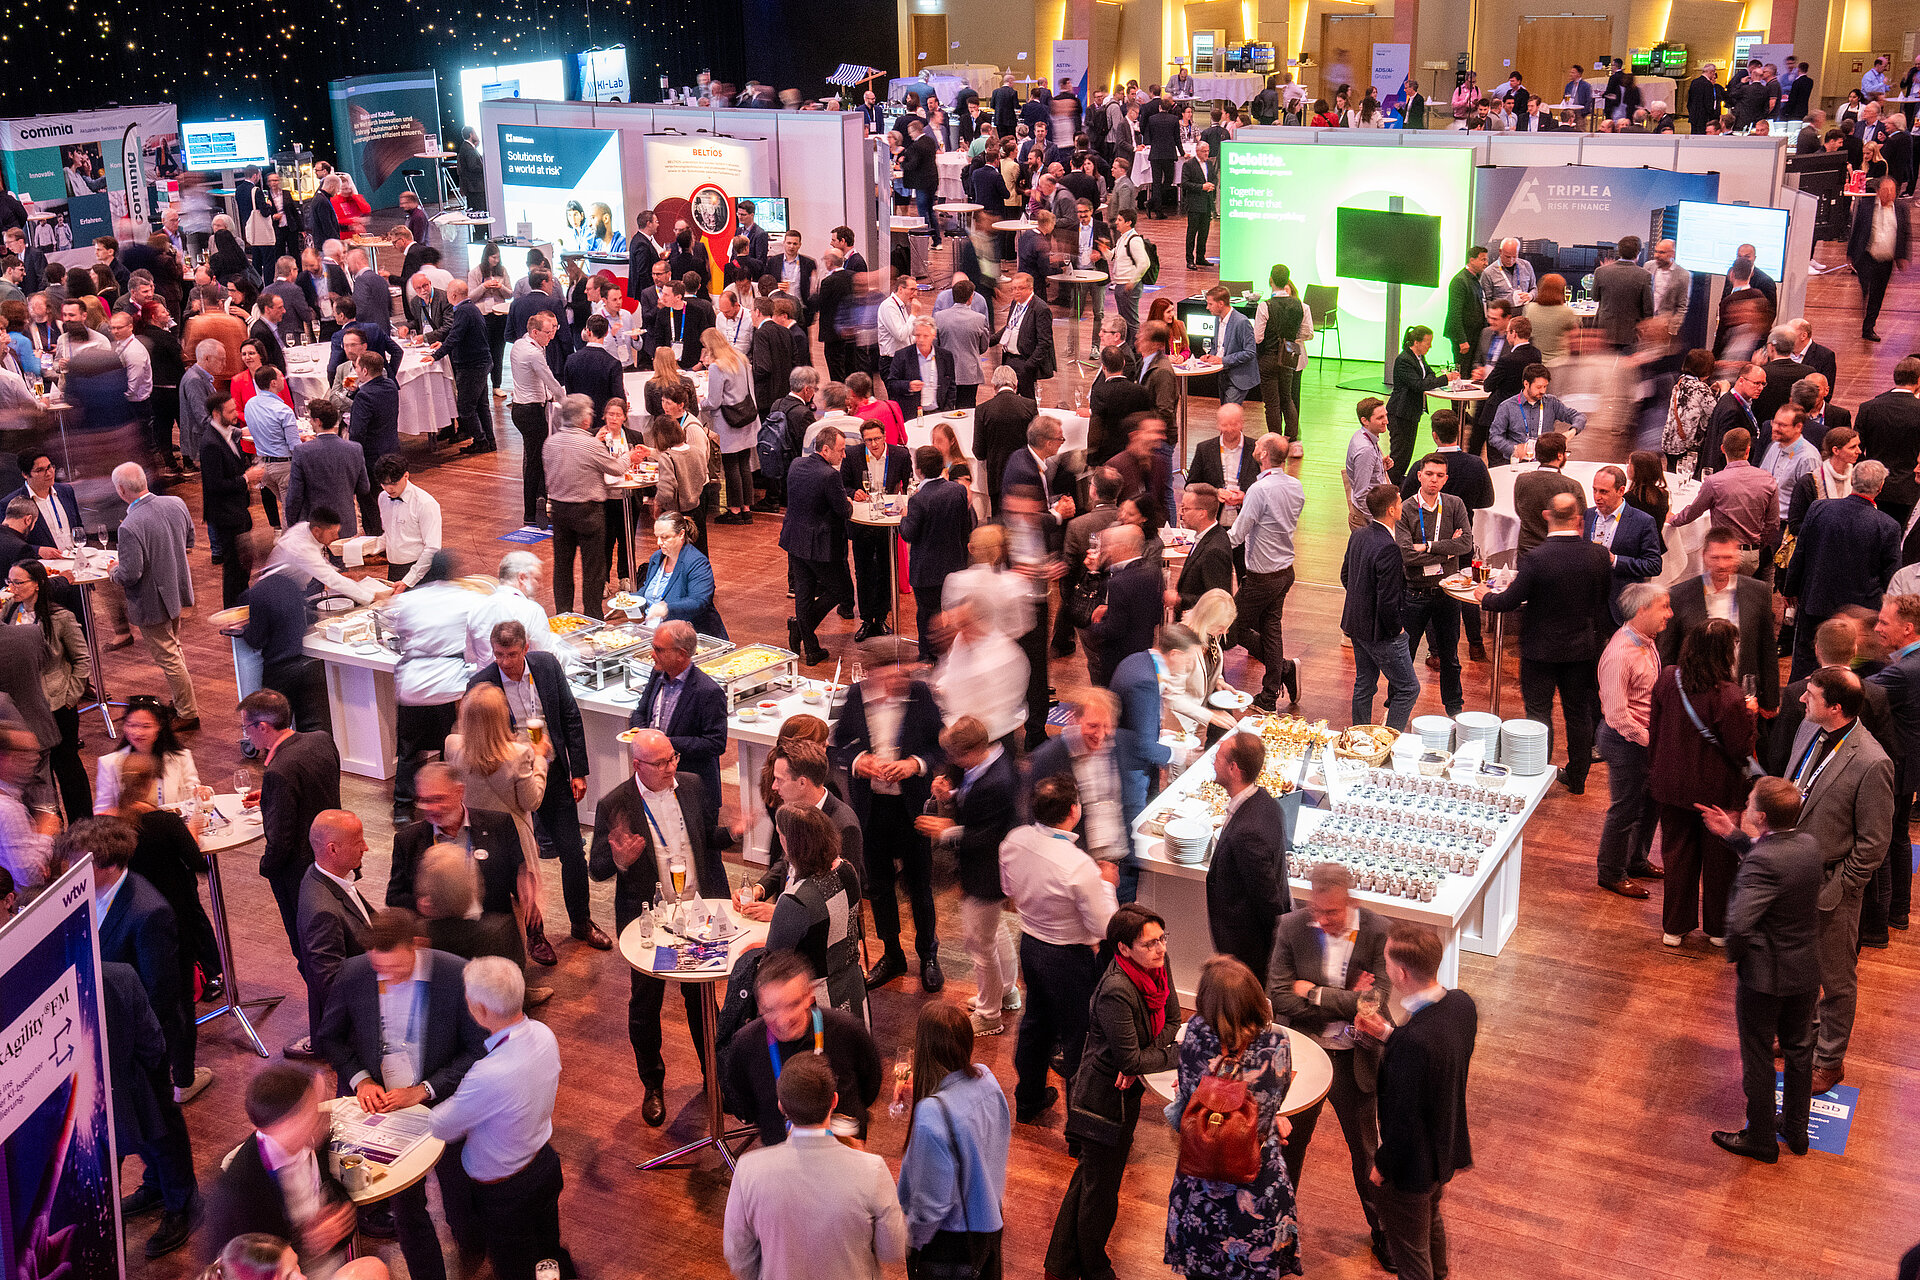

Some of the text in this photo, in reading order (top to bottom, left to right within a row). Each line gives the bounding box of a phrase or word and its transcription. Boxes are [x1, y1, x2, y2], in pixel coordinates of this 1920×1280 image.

[597, 78, 623, 90] KI-Lab
[378, 110, 396, 118] Kapital.
[379, 117, 402, 125] Innovation
[21, 124, 73, 139] cominia
[382, 131, 400, 139] effizient
[508, 151, 554, 162] Solutions for
[1229, 152, 1286, 166] Deloitte.
[29, 171, 55, 179] Innovativ.
[514, 165, 535, 174] world
[537, 166, 545, 174] at
[128, 152, 143, 225] cominia
[1229, 186, 1273, 197] Together is
[1548, 185, 1611, 197] TRIPLE A
[1229, 198, 1283, 208] the force that
[1572, 203, 1610, 211] FINANCE
[80, 217, 104, 225] Erfahren.
[62, 878, 87, 908] wtw
[3, 1080, 13, 1092] ins
[8, 1062, 43, 1100] KI-basierter
[1812, 1101, 1840, 1112] Lab
